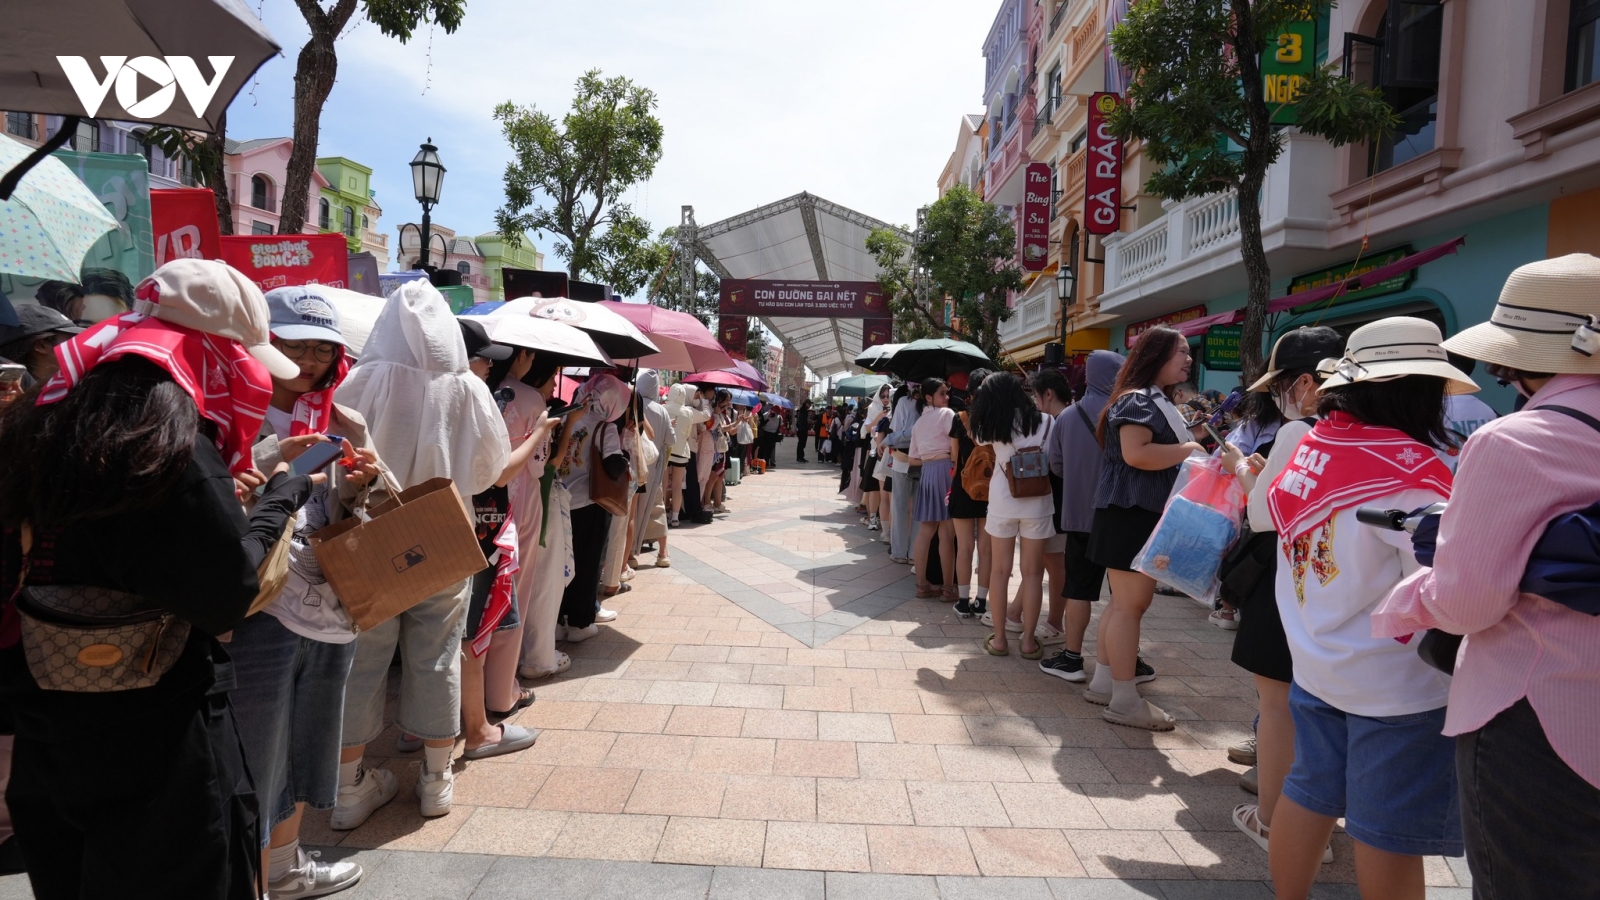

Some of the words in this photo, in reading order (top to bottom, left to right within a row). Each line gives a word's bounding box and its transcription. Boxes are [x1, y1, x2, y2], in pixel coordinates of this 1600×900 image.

[1276, 33, 1302, 63] 3
[1264, 74, 1311, 104] NGO
[1029, 171, 1048, 183] The
[1026, 191, 1050, 207] Bing
[1089, 187, 1116, 225] GÀ
[1028, 212, 1046, 224] Su
[754, 290, 775, 299] CON
[816, 291, 834, 301] GAI
[1207, 336, 1224, 346] BÚN
[1227, 338, 1241, 346] CH
[1209, 349, 1215, 358] 3
[1293, 444, 1331, 475] GAI
